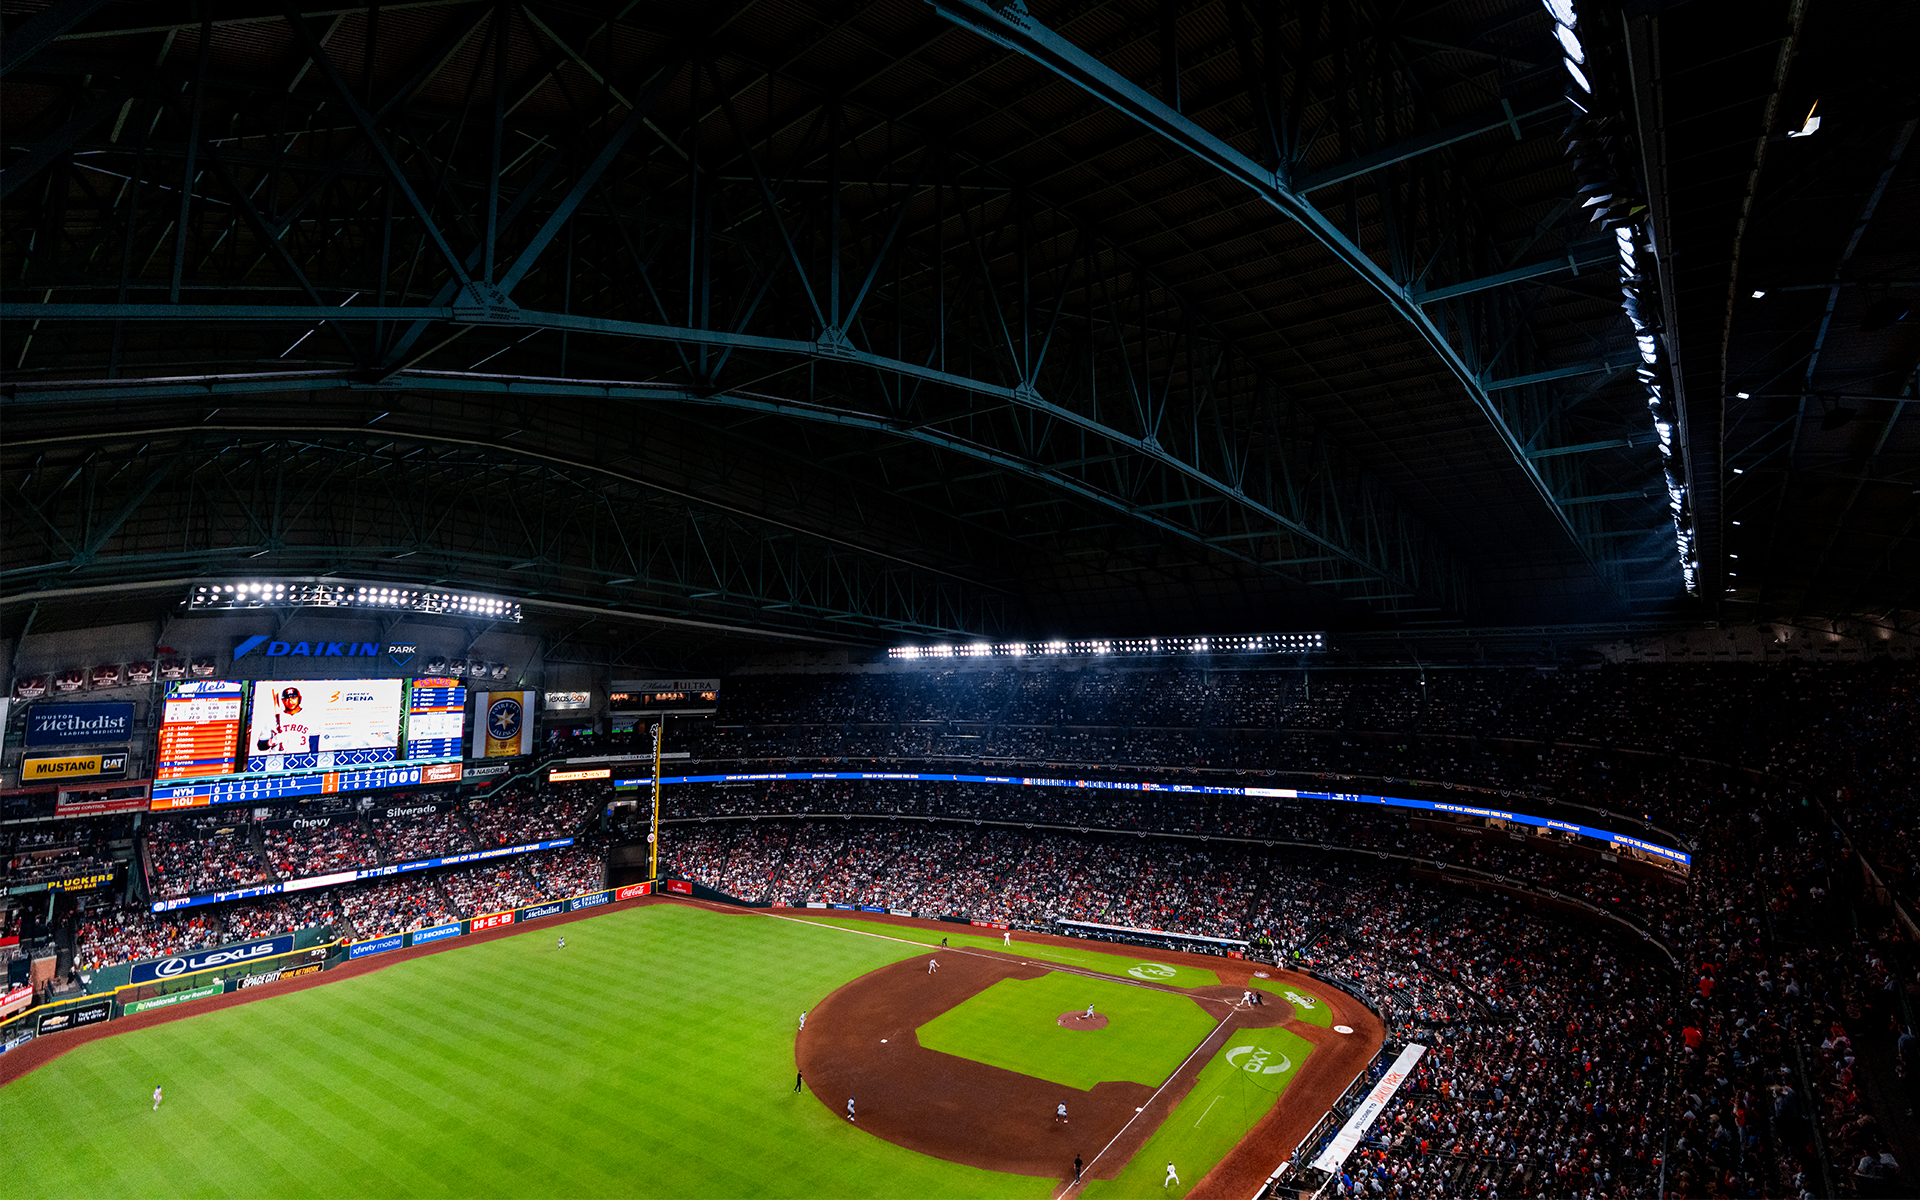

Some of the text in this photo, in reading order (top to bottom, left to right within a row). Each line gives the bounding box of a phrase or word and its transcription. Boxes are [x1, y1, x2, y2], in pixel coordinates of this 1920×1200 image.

[266, 641, 380, 656] DAIKIN
[388, 645, 417, 654] PARK
[196, 681, 226, 692] Mets
[420, 678, 452, 688] ASTROS
[548, 693, 588, 704] Texas Bay
[34, 716, 126, 732] Methodist
[300, 736, 306, 746] 3
[36, 758, 124, 773] MUSTANG CAT
[428, 766, 451, 776] planet
[389, 770, 419, 784] 0 0 0
[173, 788, 194, 797] NYM
[172, 797, 194, 806] HOU
[386, 805, 437, 818] Silverado
[293, 817, 330, 830] Chevy
[1547, 820, 1580, 831] planet fitness
[48, 873, 114, 889] PLUCKERS
[267, 885, 275, 893] K
[621, 885, 645, 898] Coca-Cola
[581, 893, 603, 901] ENERGY
[581, 897, 608, 908] TRANSFER
[526, 905, 560, 919] Methodist
[423, 926, 460, 939] HONDA
[352, 938, 401, 955] xfinity mobile
[189, 943, 274, 969] LEXUS
[242, 965, 320, 988] SPACE CITY HOME NETWORK
[1130, 966, 1176, 977] OXY
[145, 996, 177, 1009] National
[191, 989, 214, 998] Rental
[1243, 1047, 1271, 1073] OXY
[1354, 1109, 1373, 1129] WELCOME
[1369, 1084, 1394, 1104] DAIKIN
[1382, 1071, 1405, 1086] PARK
